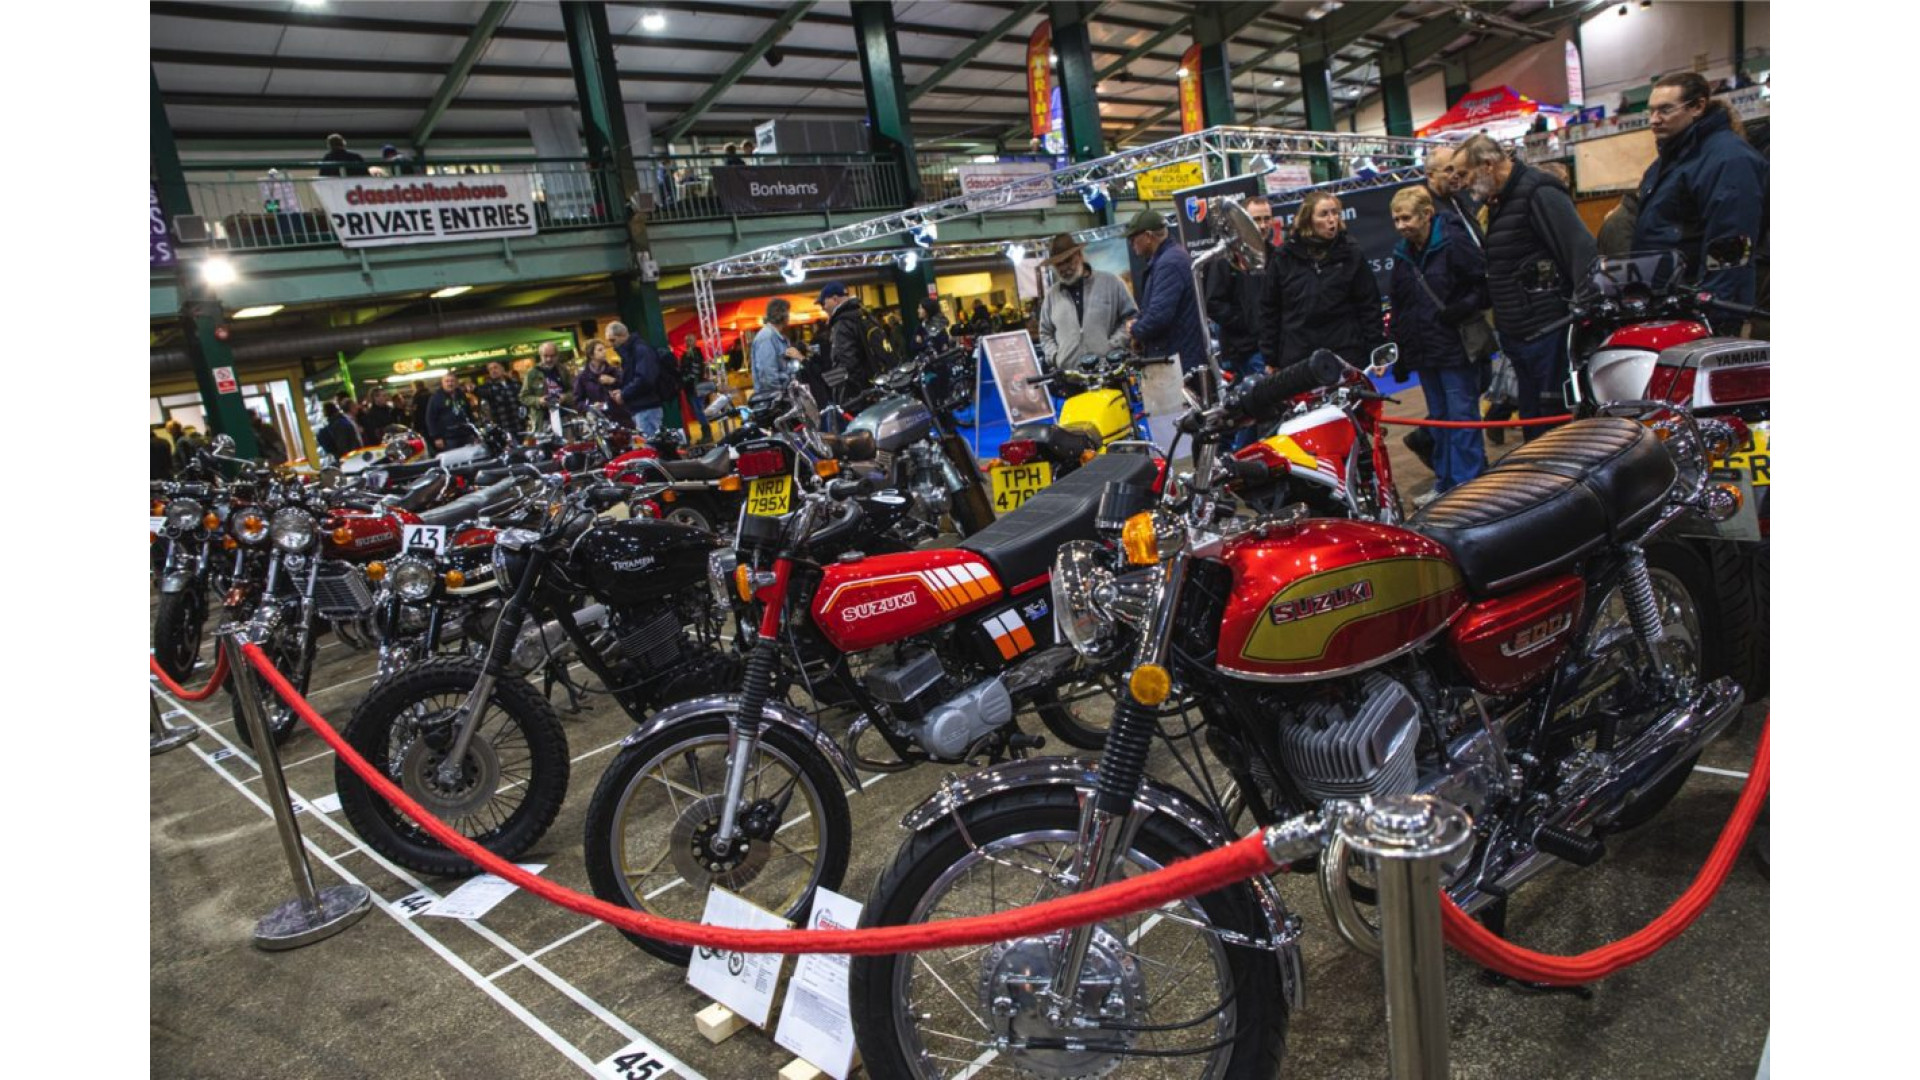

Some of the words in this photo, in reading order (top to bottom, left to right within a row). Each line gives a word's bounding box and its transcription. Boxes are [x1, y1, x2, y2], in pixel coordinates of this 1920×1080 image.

[346, 182, 508, 205] classicbikeshows
[750, 180, 819, 197] Bonhams
[440, 203, 530, 230] ENTRIES
[1715, 350, 1769, 367] YAMAHA
[756, 480, 784, 497] NRD
[1000, 468, 1042, 488] TPH
[751, 496, 788, 513] 795X
[409, 528, 440, 550] 43
[842, 591, 917, 621] SUZUKI
[1268, 580, 1373, 625] SUZUKI
[613, 1052, 665, 1080] 45
